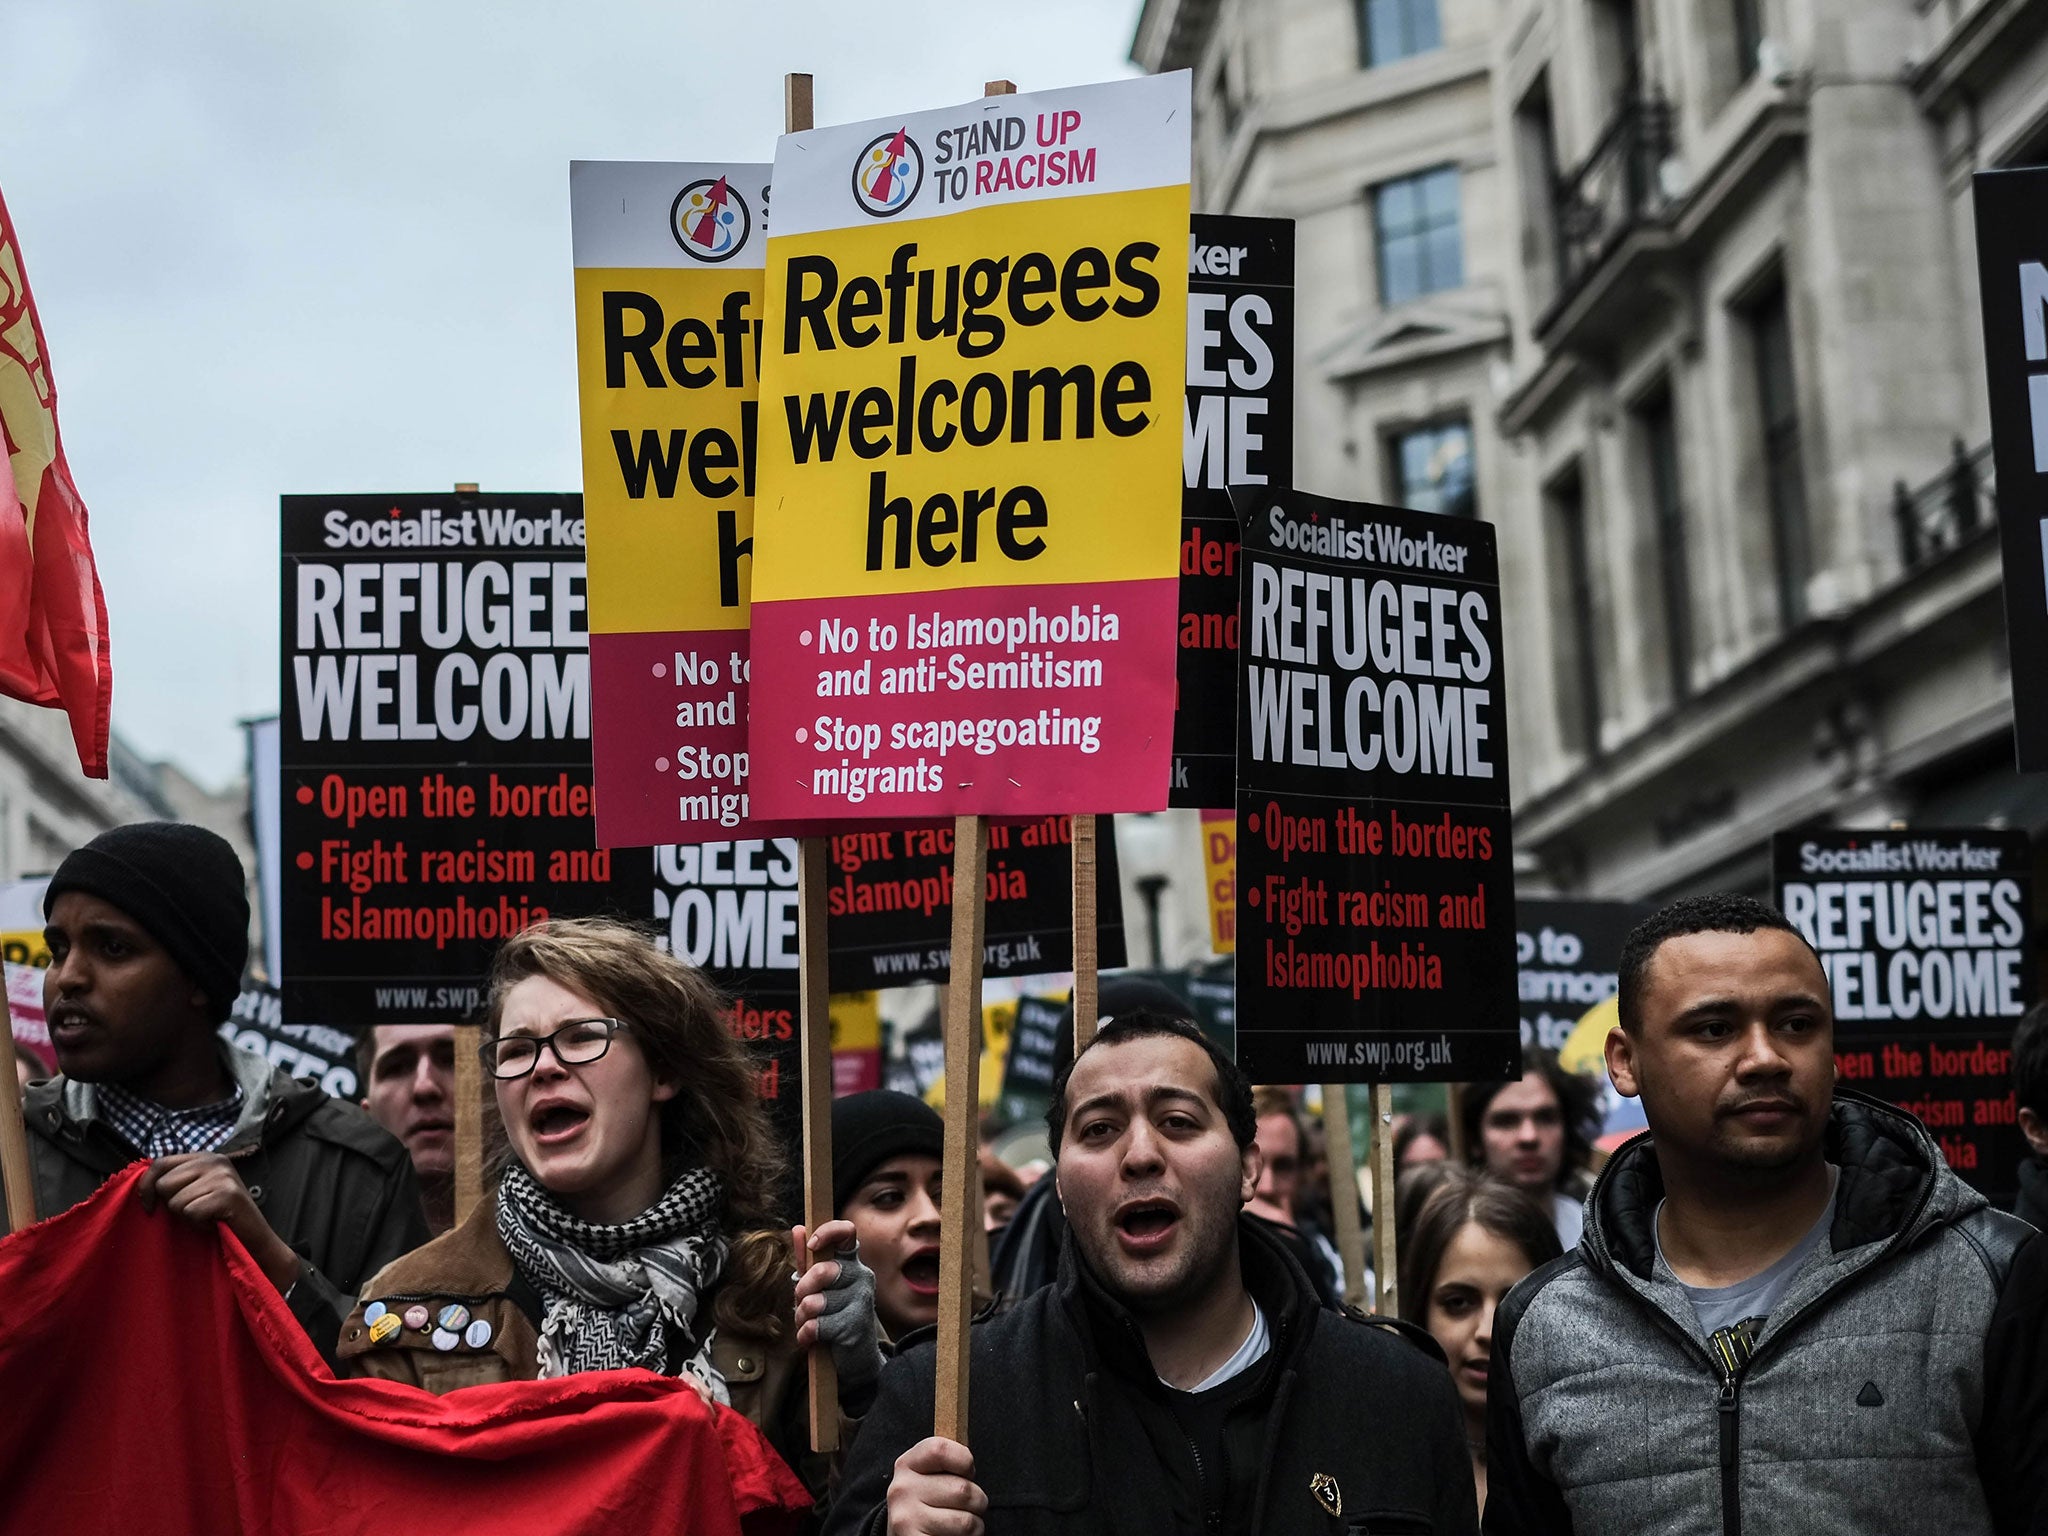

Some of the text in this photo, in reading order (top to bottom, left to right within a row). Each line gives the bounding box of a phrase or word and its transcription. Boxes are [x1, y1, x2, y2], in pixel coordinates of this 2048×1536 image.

[934, 110, 1081, 165] STAND UP
[934, 147, 1097, 204] TO RACISM
[783, 241, 1161, 359] Refugees
[783, 355, 1152, 465] welcome
[324, 507, 476, 549] Socialist
[865, 471, 1048, 572] here
[1269, 505, 1468, 574] Socialist Worker
[819, 604, 1119, 654] No to Islamophobia
[1251, 561, 1492, 683] REFUGEES
[675, 651, 719, 686] No
[816, 651, 1102, 698] and anti-Semitism
[676, 691, 736, 728] and
[813, 708, 1102, 759] Stop scapegoating
[1248, 664, 1494, 779] WELCOME
[677, 745, 749, 786] Stop
[812, 758, 943, 803] migrants
[321, 773, 407, 828] Open
[420, 773, 476, 818] the
[1265, 801, 1493, 862] Open the borders
[321, 839, 611, 895] Fight racism and
[653, 837, 799, 887] GEES
[1265, 874, 1486, 936] Fight racism and
[1783, 879, 2024, 950] REFUGEES
[1266, 938, 1443, 1001] Islamophobia
[1820, 950, 2025, 1020] ELCOME
[1306, 1034, 1452, 1071] www.swp.org.uk
[1882, 1041, 1923, 1079] the
[1972, 1090, 2017, 1126] and
